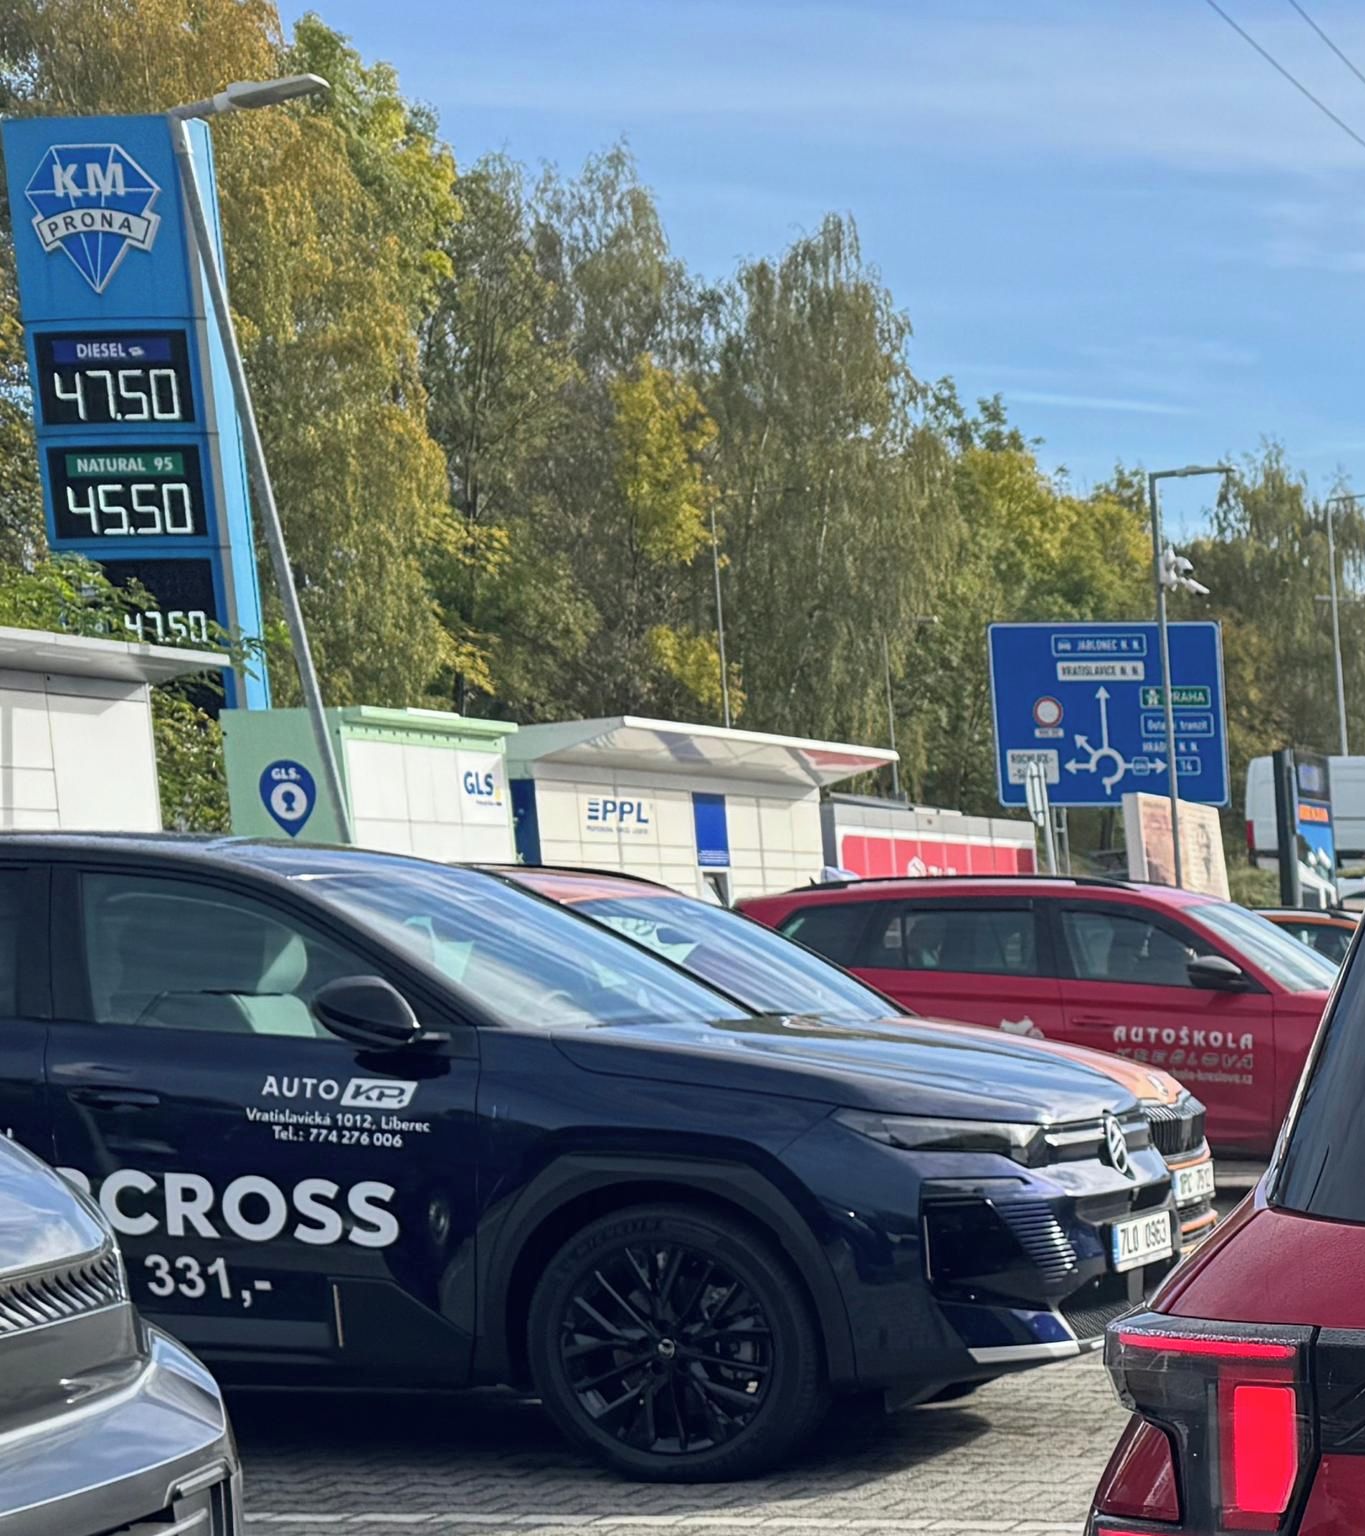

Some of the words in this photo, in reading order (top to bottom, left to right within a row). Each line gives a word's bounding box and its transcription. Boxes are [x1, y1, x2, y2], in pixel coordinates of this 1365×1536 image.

[52, 162, 125, 197] KM
[47, 212, 134, 238] PRONA
[76, 343, 126, 358] DIESEL
[54, 368, 182, 421] 47.50
[77, 457, 146, 473] NATURAL
[153, 456, 174, 472] 95
[66, 482, 194, 536] 45.50
[1171, 690, 1206, 702] RAHA
[1112, 1025, 1254, 1050] AUTOŠKOLA
[261, 1075, 340, 1101] AUTO
[245, 1107, 331, 1126] Vratislavická
[336, 1112, 377, 1131] 1012,
[381, 1116, 430, 1134] Liberec
[272, 1124, 304, 1142] Tel.:
[309, 1128, 338, 1144] 774
[341, 1130, 370, 1145] 276
[373, 1132, 403, 1148] 006
